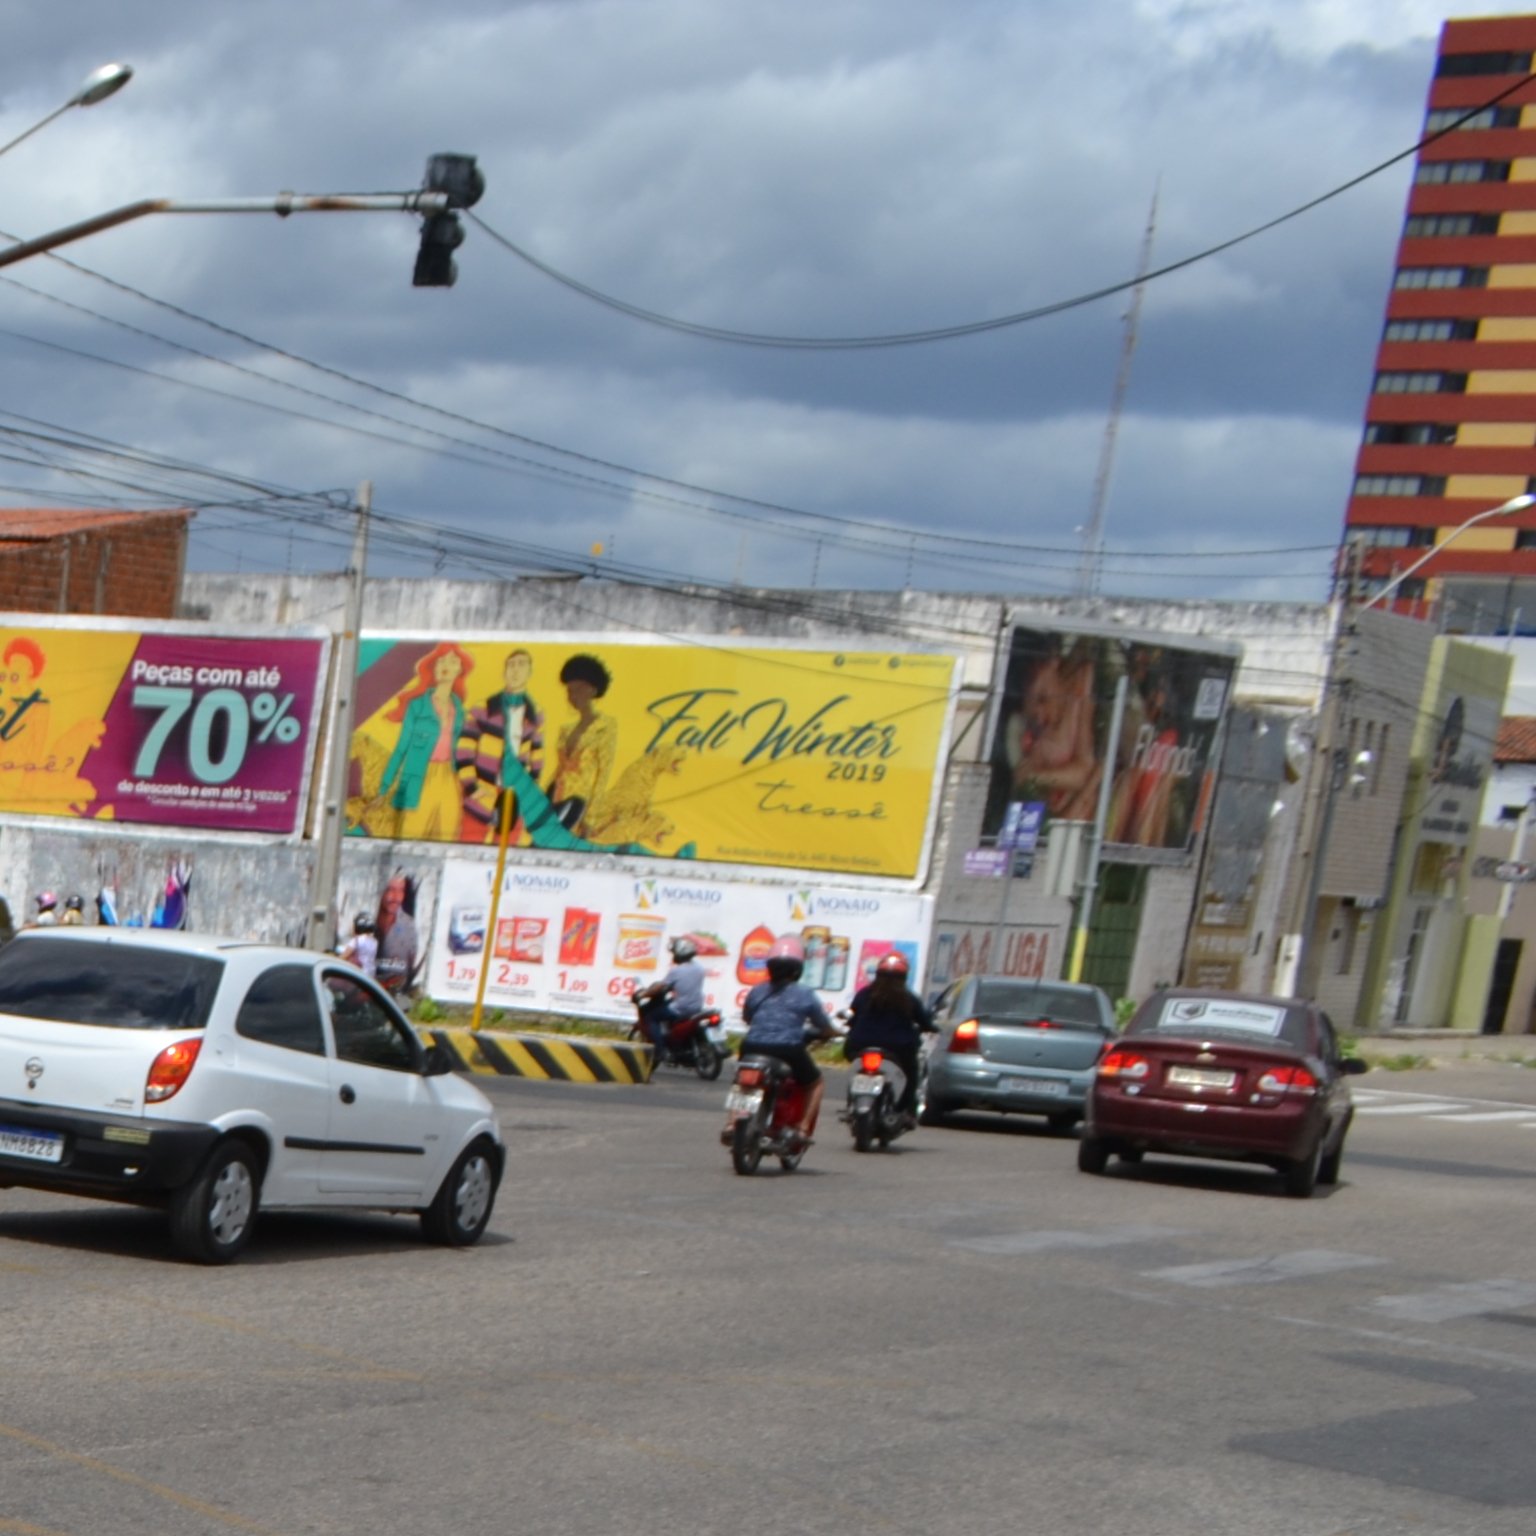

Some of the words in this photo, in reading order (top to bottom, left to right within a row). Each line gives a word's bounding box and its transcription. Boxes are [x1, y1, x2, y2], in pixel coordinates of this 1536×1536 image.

[10, 672, 20, 683] o
[132, 660, 194, 686] Peças
[196, 667, 242, 684] com
[244, 666, 282, 688] até
[132, 685, 301, 785] 70%
[645, 688, 741, 756] Fall
[739, 694, 903, 765] Winter
[826, 761, 888, 782] 2019
[117, 780, 134, 793] de
[135, 780, 189, 796] desconto
[190, 786, 199, 796] e
[200, 786, 220, 798] em
[221, 786, 242, 799] até
[243, 788, 252, 801] 3
[755, 779, 889, 821] tressê
[446, 959, 476, 981] 1,79
[497, 964, 529, 986] 2,39
[558, 971, 588, 992] 1,09
